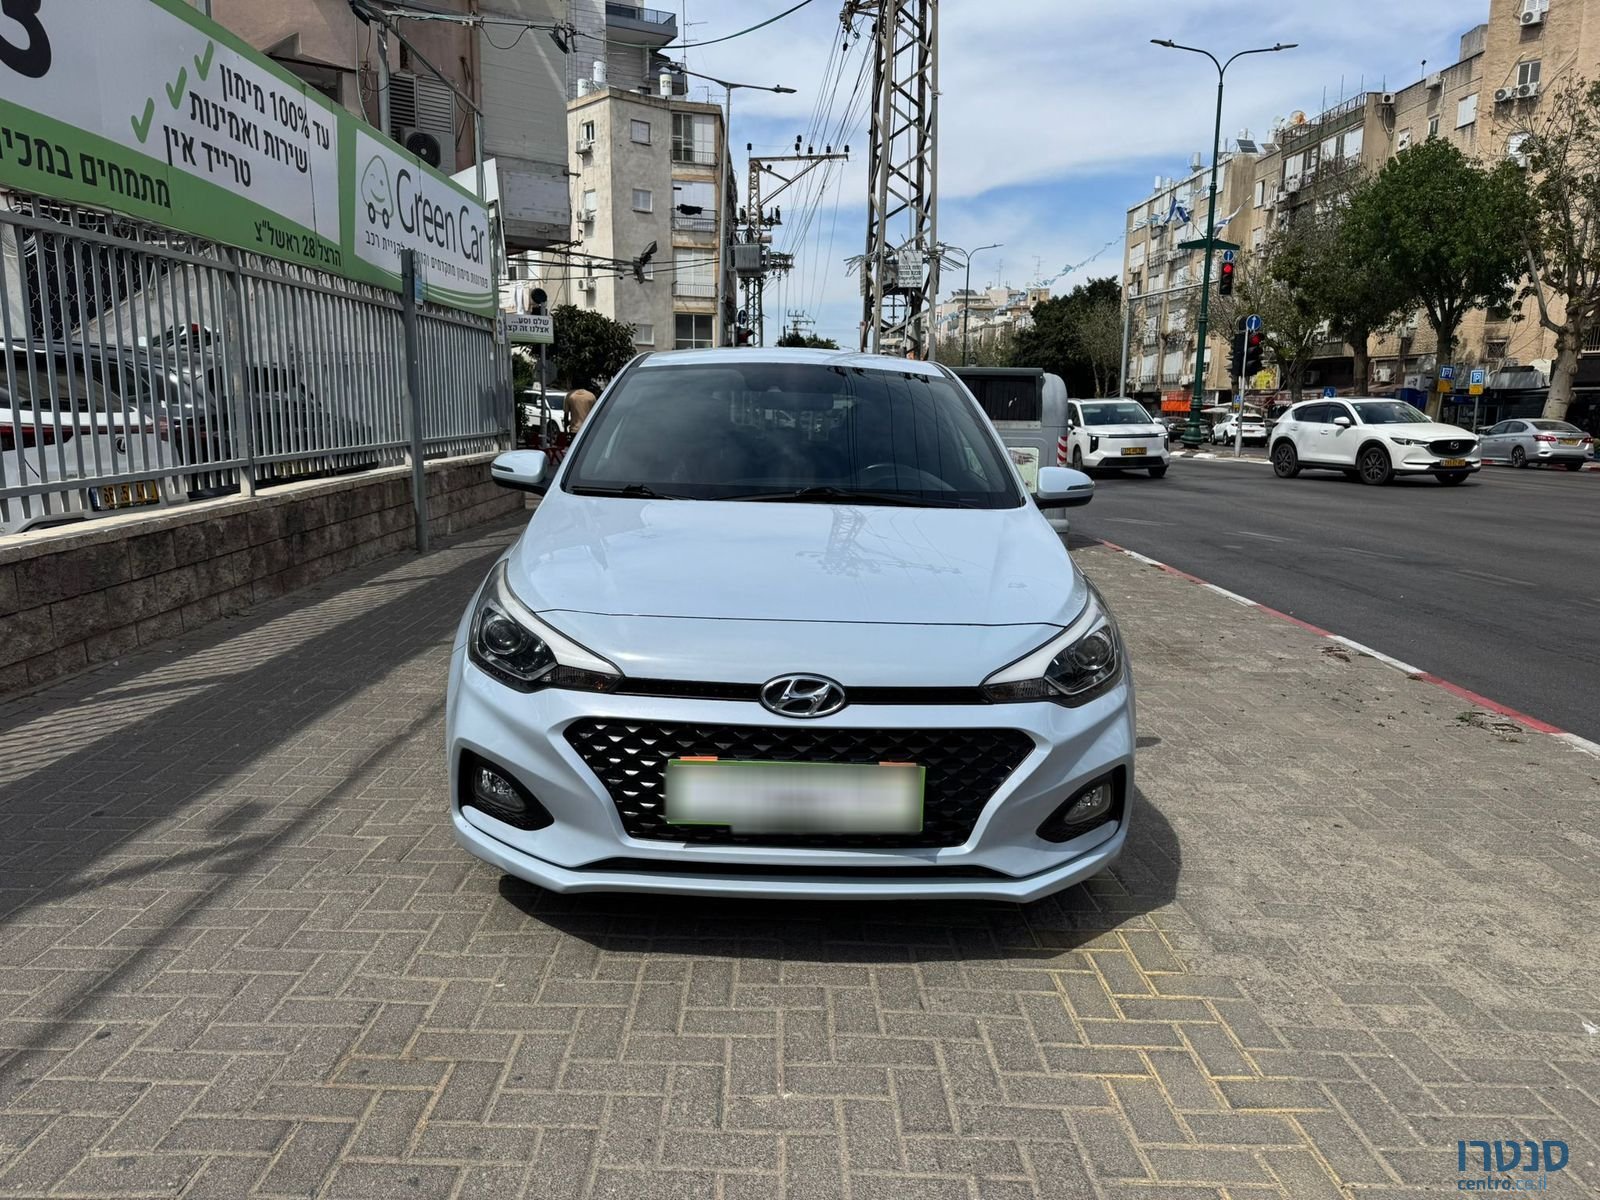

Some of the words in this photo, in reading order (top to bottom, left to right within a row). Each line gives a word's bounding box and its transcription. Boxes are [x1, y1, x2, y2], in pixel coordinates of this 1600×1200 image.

[219, 63, 265, 114] מימון
[189, 90, 259, 150] ואמינות
[270, 91, 310, 140] 100%
[312, 120, 330, 150] עד
[0, 126, 73, 180] במכי
[163, 125, 197, 166] אין
[201, 142, 251, 187] טרייד
[263, 130, 308, 173] שירות
[80, 152, 171, 208] מתמחים
[396, 168, 457, 253] Green
[459, 205, 485, 265] Car
[302, 235, 316, 258] 28
[317, 239, 341, 267] הרצל
[365, 230, 380, 248] רכב
[530, 325, 549, 333] אצלנו
[533, 317, 549, 326] שלם
